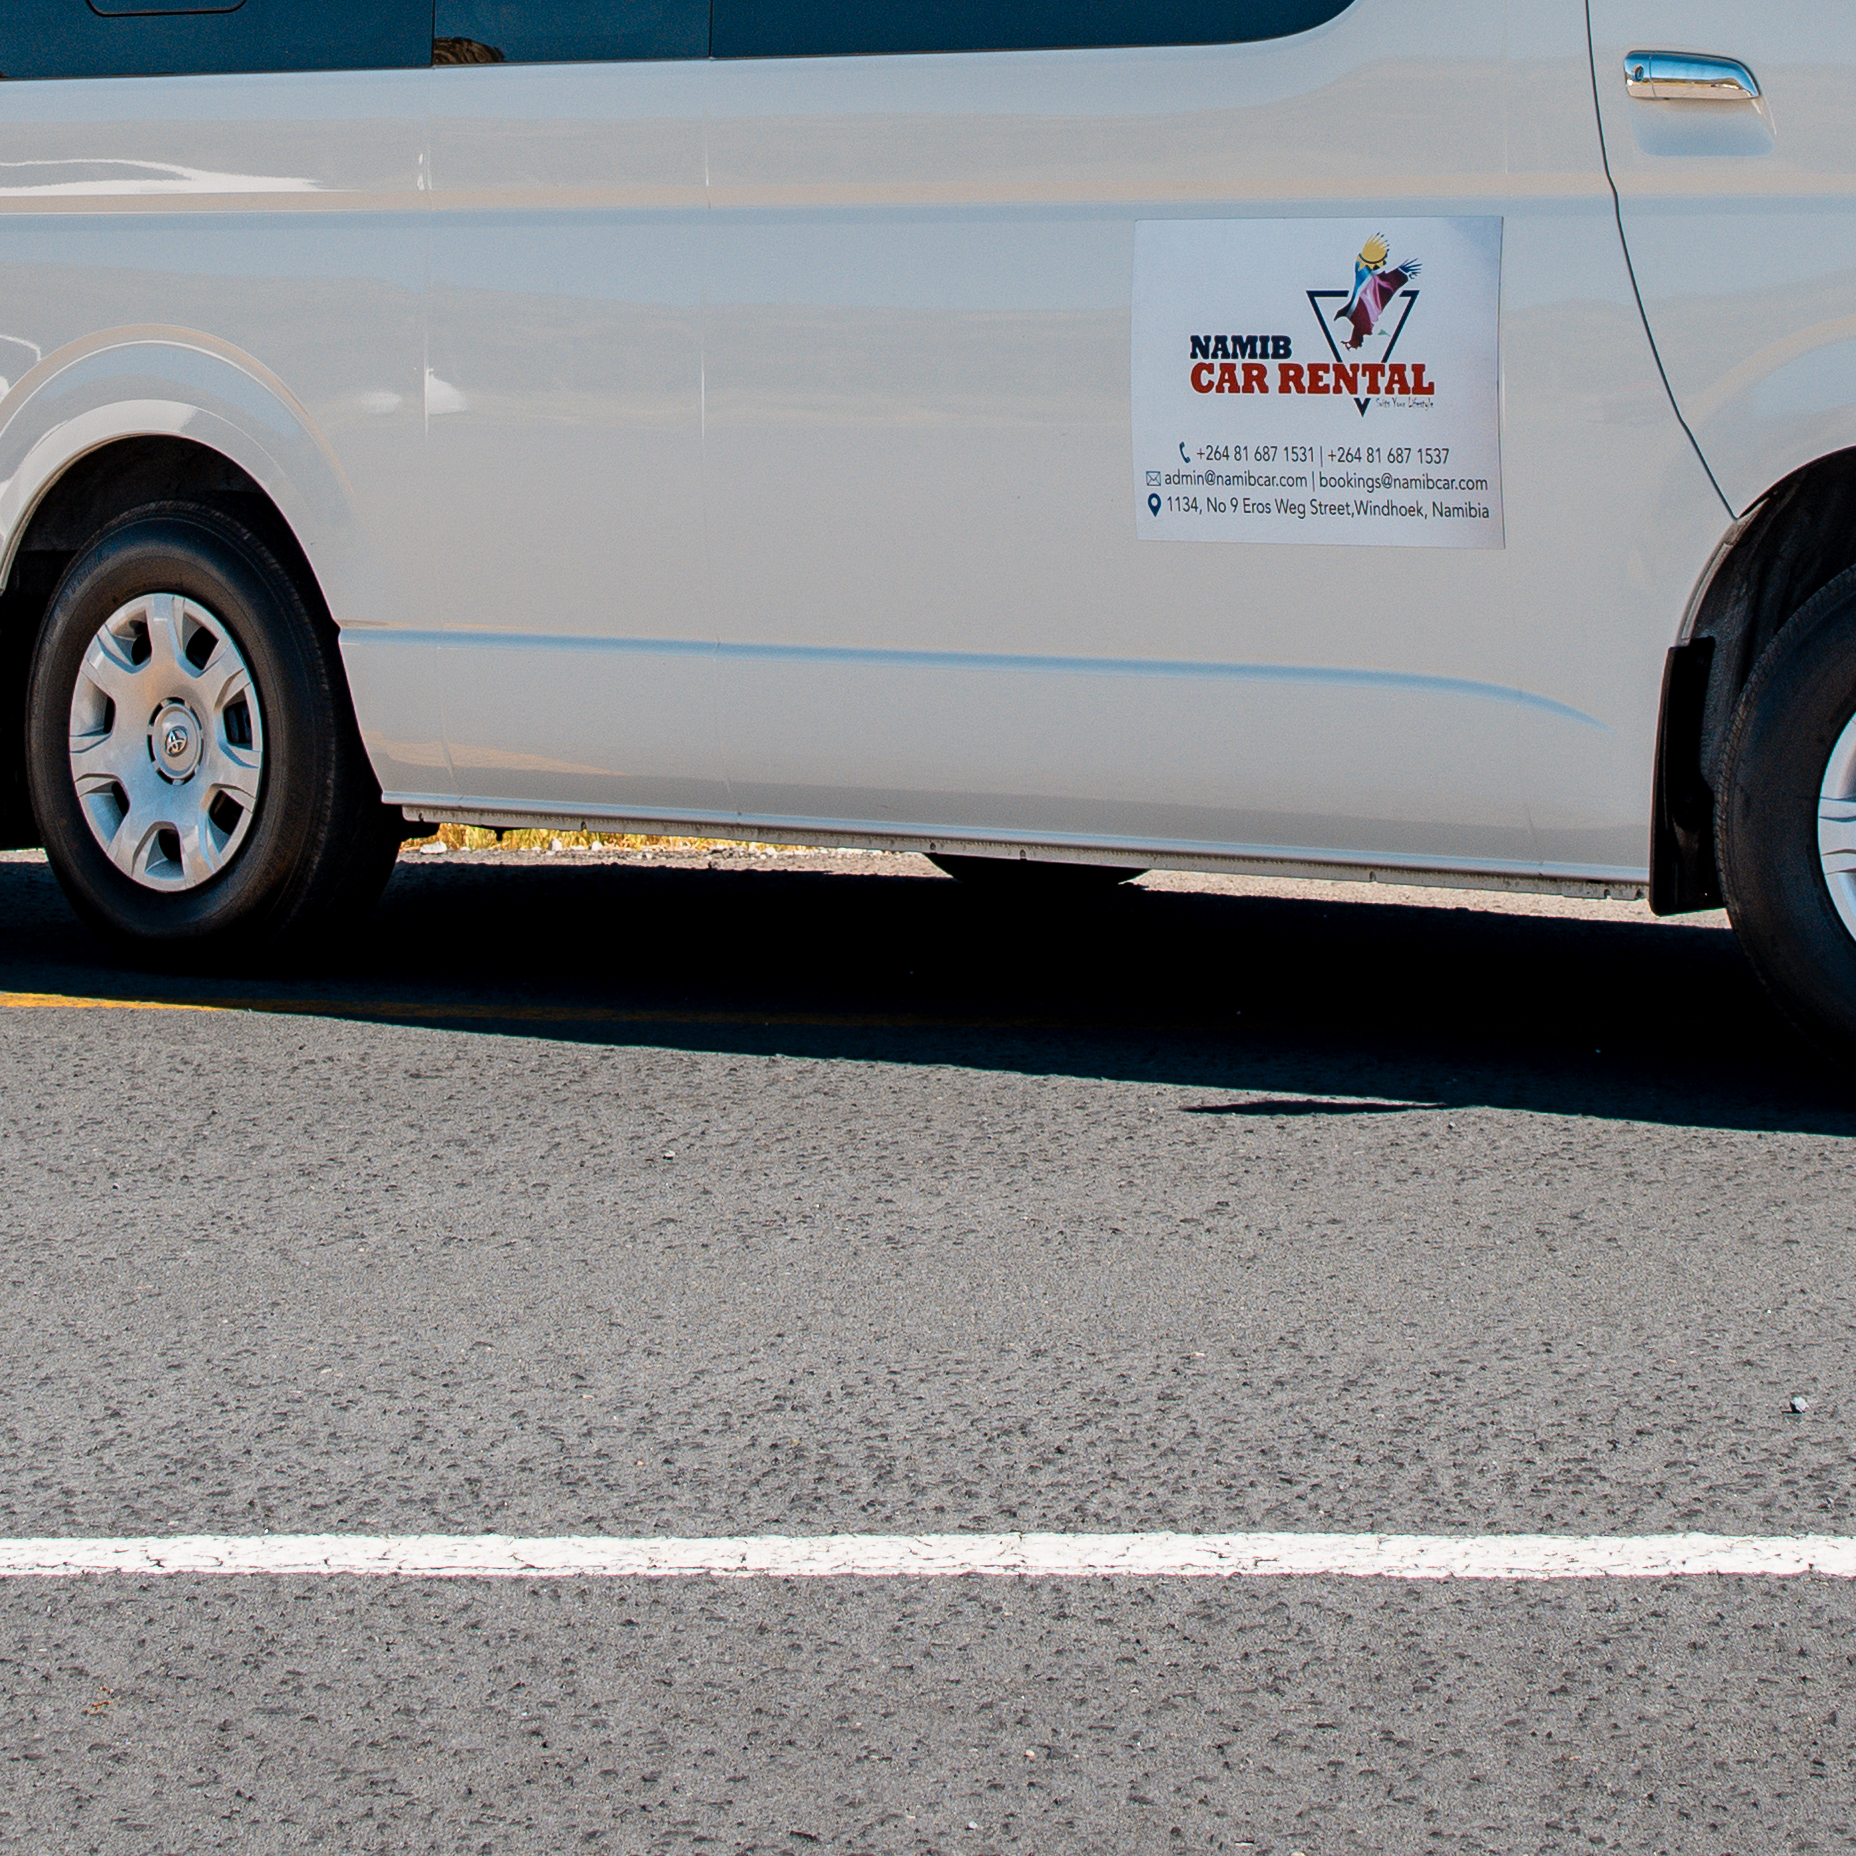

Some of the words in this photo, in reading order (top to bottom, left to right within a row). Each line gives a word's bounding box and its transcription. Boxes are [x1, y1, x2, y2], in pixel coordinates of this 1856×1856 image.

[1189, 335, 1292, 359] NAMIB
[1190, 362, 1269, 394] CAR
[1278, 363, 1435, 395] RENTAL
[1196, 445, 1229, 461] +264
[1234, 445, 1249, 461] 81
[1254, 445, 1278, 462] 687
[1283, 446, 1314, 463] 1531
[1328, 446, 1362, 463] +264
[1366, 446, 1381, 463] 81
[1387, 447, 1411, 464] 687
[1417, 447, 1450, 465] 1537
[1164, 469, 1308, 488] admin@namibcar.com
[1319, 471, 1489, 493] bookings@namibcar.com
[1167, 496, 1203, 515] 1134,
[1206, 496, 1226, 513] No
[1230, 497, 1239, 513] 9
[1243, 497, 1271, 514] Eros
[1275, 498, 1306, 519] Weg
[1432, 501, 1490, 519] Namibia
